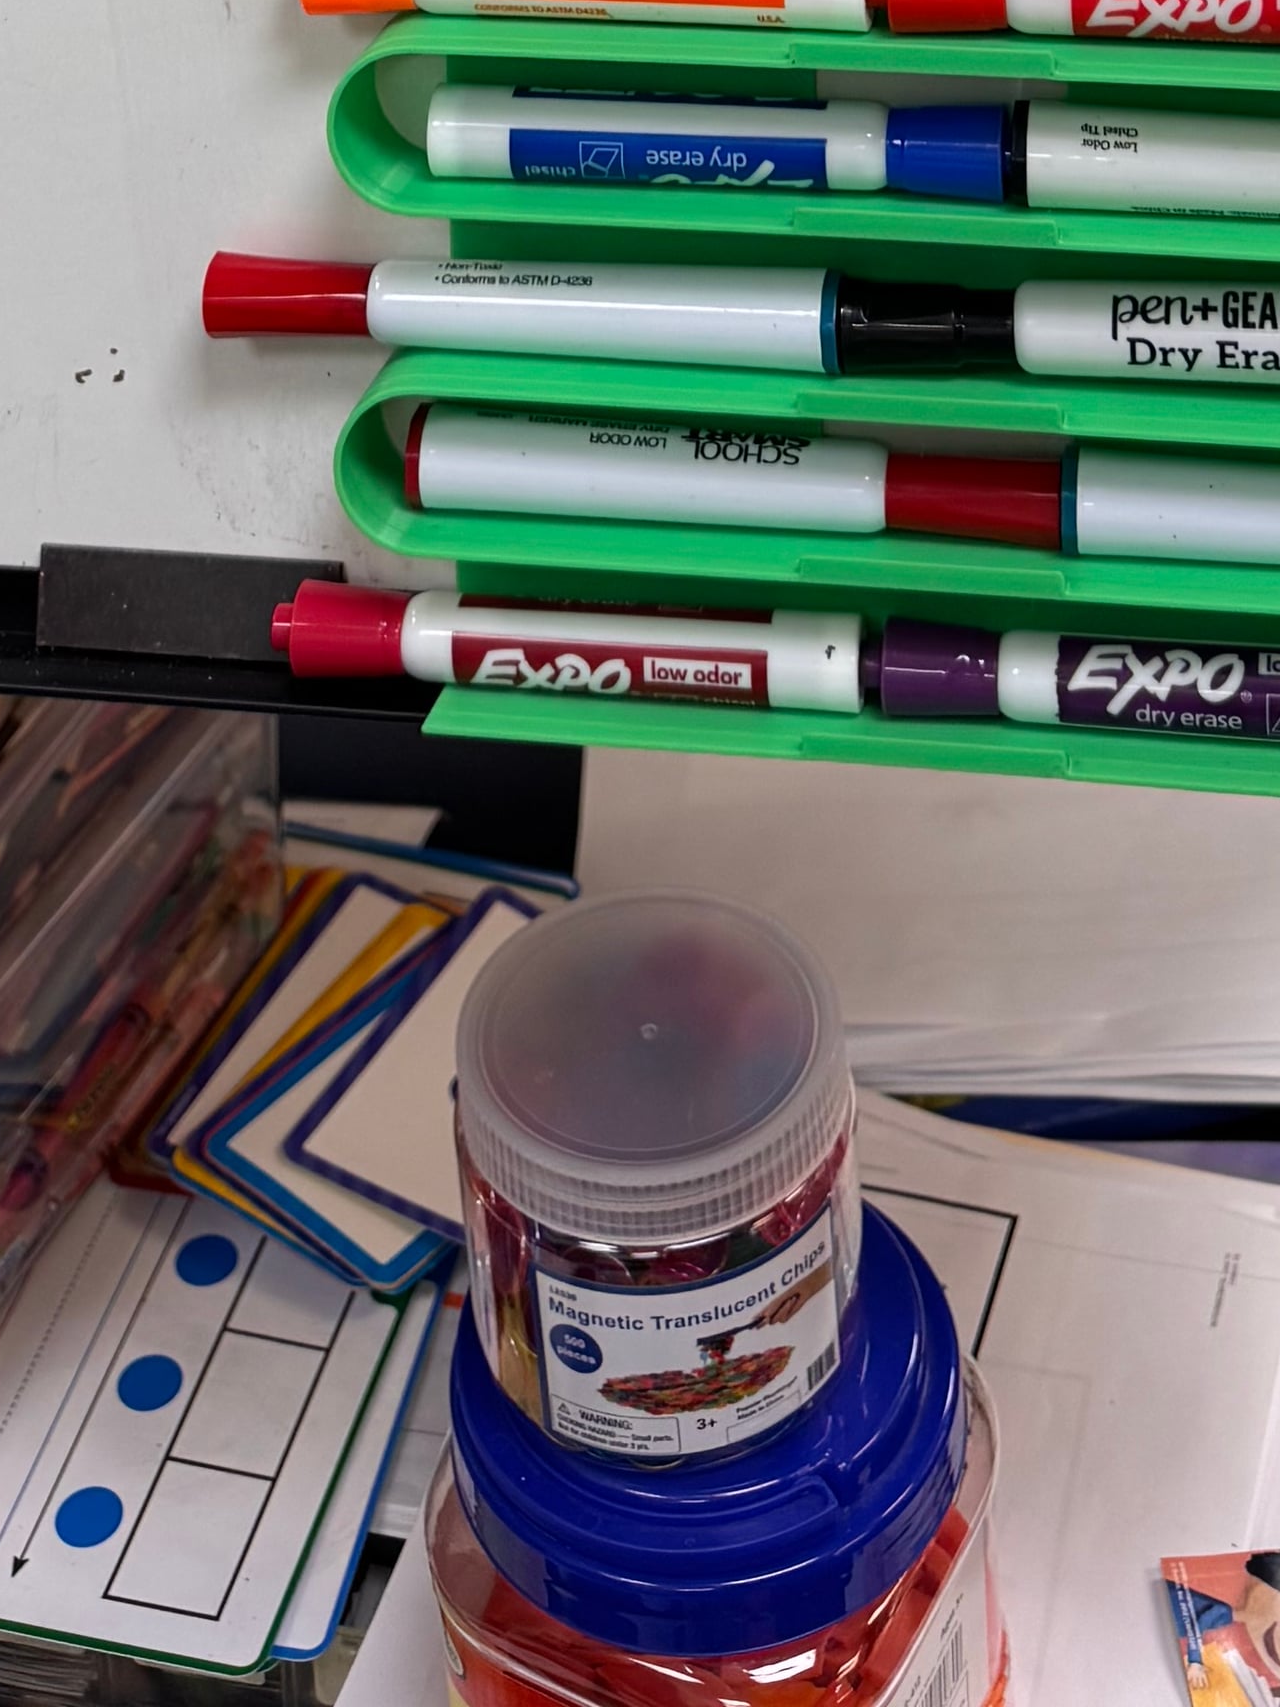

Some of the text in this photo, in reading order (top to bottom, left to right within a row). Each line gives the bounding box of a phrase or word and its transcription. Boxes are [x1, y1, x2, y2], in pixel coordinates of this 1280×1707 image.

[1081, 123, 1138, 138] Chisel Tip
[1081, 137, 1138, 154] Low Odor
[525, 165, 575, 177] chisel
[646, 149, 747, 172] dry erase
[441, 274, 593, 287] Conforms to ASTM D-4236
[1127, 340, 1201, 371] Dry
[590, 431, 667, 450] LOW ODOR
[694, 440, 801, 466] SCHOOL
[473, 649, 631, 691] EXPO
[650, 660, 742, 687] low odor
[1067, 644, 1246, 716] EXPO
[1136, 704, 1242, 731] dry erase
[548, 1239, 825, 1332] Magnetic Translucent Chips
[578, 1409, 633, 1430] WARNING:
[696, 1417, 717, 1430] 3+
